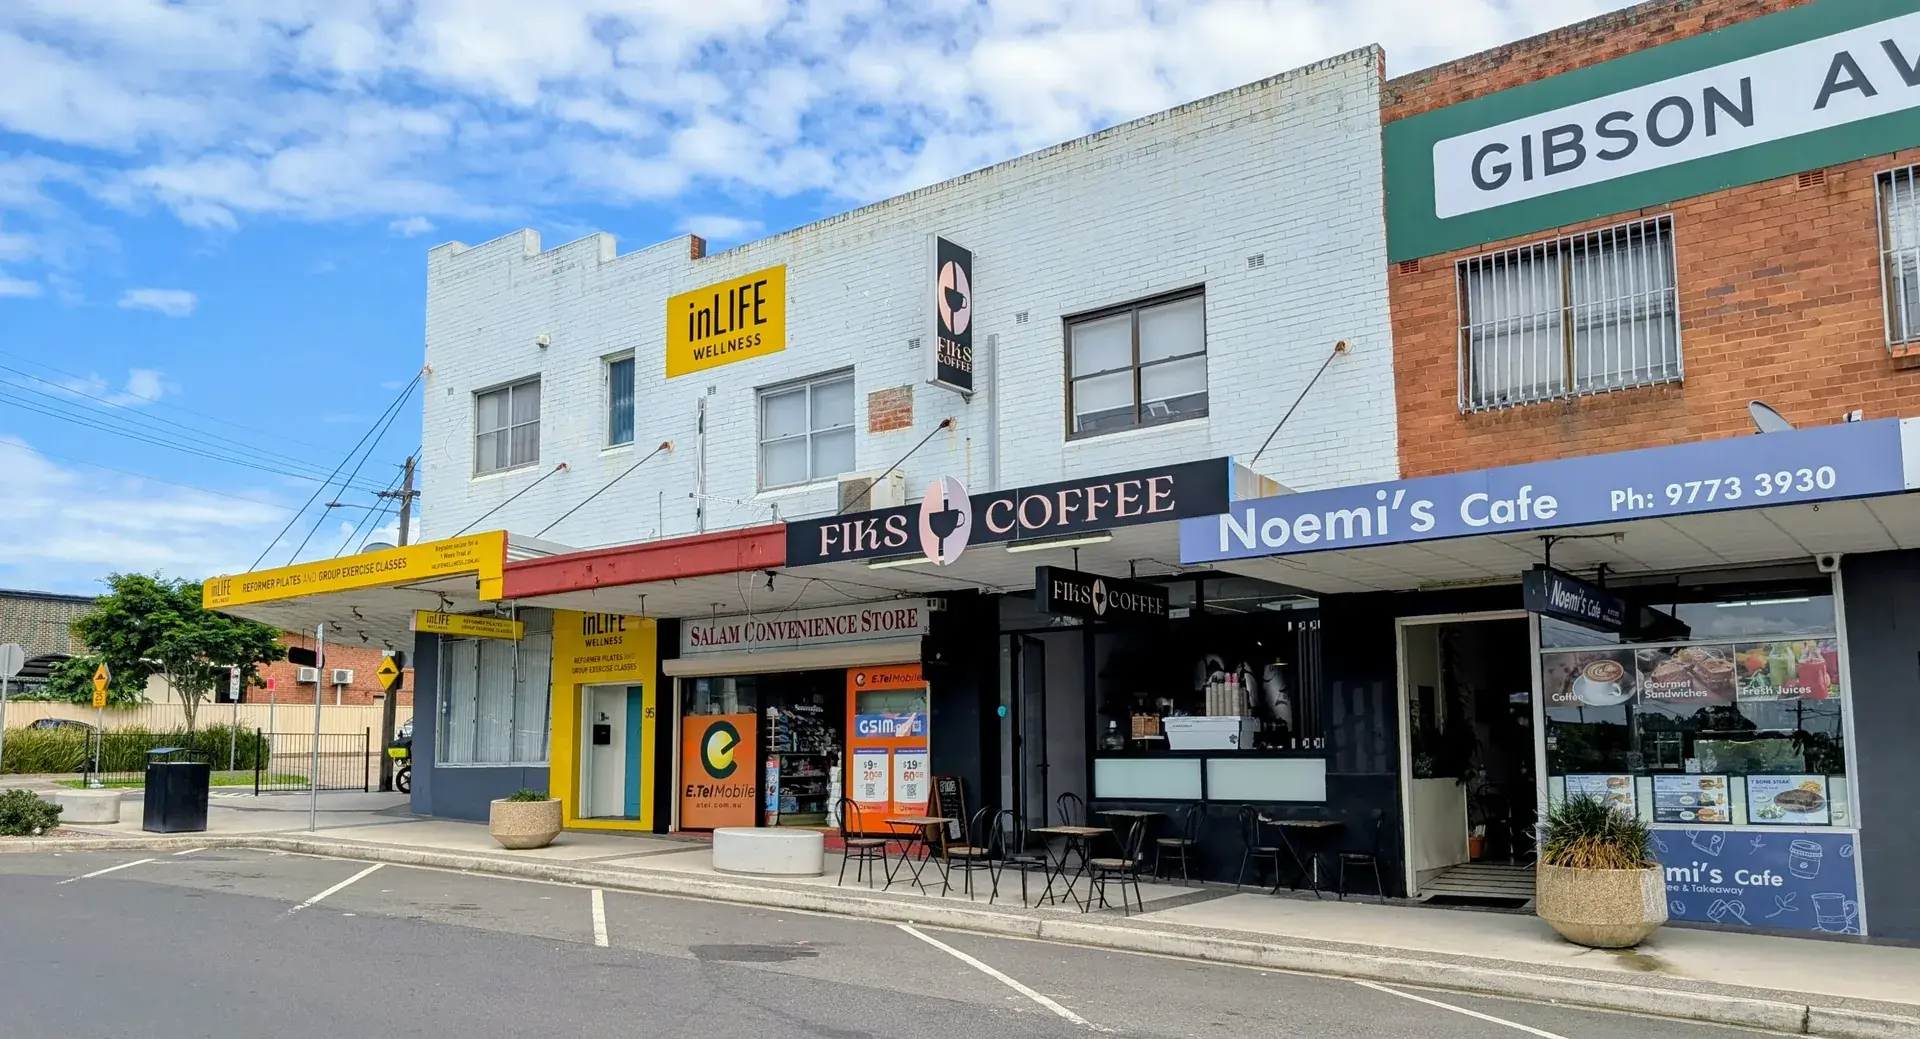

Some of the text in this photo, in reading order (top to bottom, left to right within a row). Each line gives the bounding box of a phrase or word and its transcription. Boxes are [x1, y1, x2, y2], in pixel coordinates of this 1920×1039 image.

[1471, 76, 1755, 191] GIBSON
[689, 279, 768, 342] inLIFE
[693, 332, 762, 361] WELLNESS
[937, 336, 972, 363] FIKS
[937, 352, 972, 373] COFFEE
[819, 475, 1176, 557] FIKS COFFEE
[1219, 466, 1837, 552] Noemi's Cafe Ph: 9773 3930
[242, 580, 275, 593] REFORMER
[276, 574, 301, 588] PILATES
[318, 567, 341, 582] GROUP
[342, 562, 375, 578] EXERCISE
[376, 557, 407, 573] CLASSES
[211, 579, 231, 597] inLIFE
[1054, 580, 1165, 615] FIKS COFFEE
[1551, 580, 1601, 619] Noemi's Cafe
[426, 613, 451, 625] inLIFE
[583, 612, 627, 635] inLIFE
[690, 608, 918, 647] SALAM CONVENIENCE STORE
[585, 636, 623, 647] WELLNESS
[573, 655, 601, 664] REFORMER
[601, 653, 623, 662] PILATES
[589, 665, 613, 673] EXERCISE
[614, 663, 637, 671] CLASSES
[1644, 679, 1691, 690] Gourmet
[1645, 688, 1708, 699] Sandwiches
[1742, 685, 1812, 695] Fresh Juices
[1552, 693, 1584, 702] Coffee
[645, 707, 655, 719] 95
[685, 784, 755, 798] E.TelMobile
[1734, 869, 1783, 887] Cafe
[1682, 884, 1689, 892] &
[1691, 884, 1744, 896] Takeaway
